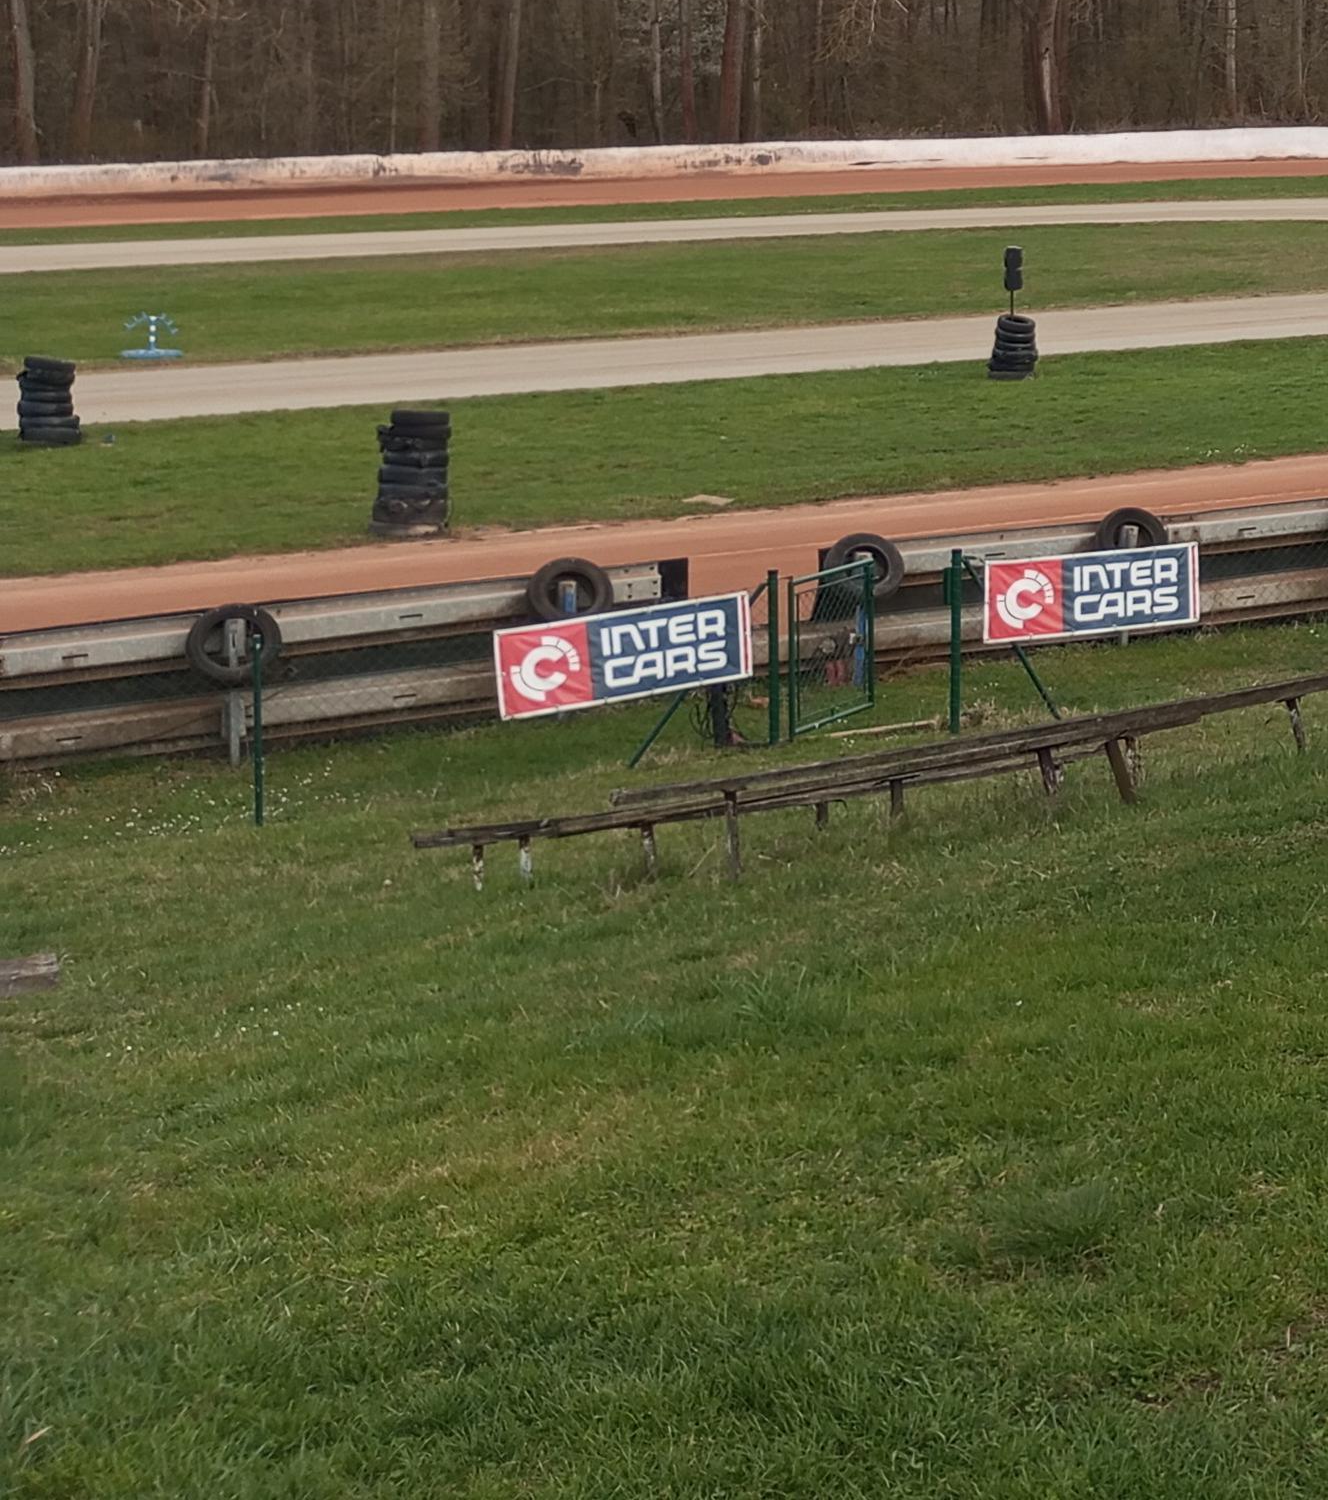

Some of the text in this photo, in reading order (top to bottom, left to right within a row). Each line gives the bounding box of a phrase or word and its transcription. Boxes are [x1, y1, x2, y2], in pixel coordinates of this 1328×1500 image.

[1073, 556, 1180, 594] INTER
[1073, 586, 1180, 622] CARS
[600, 608, 728, 658] INTER
[602, 640, 728, 690] CARS
